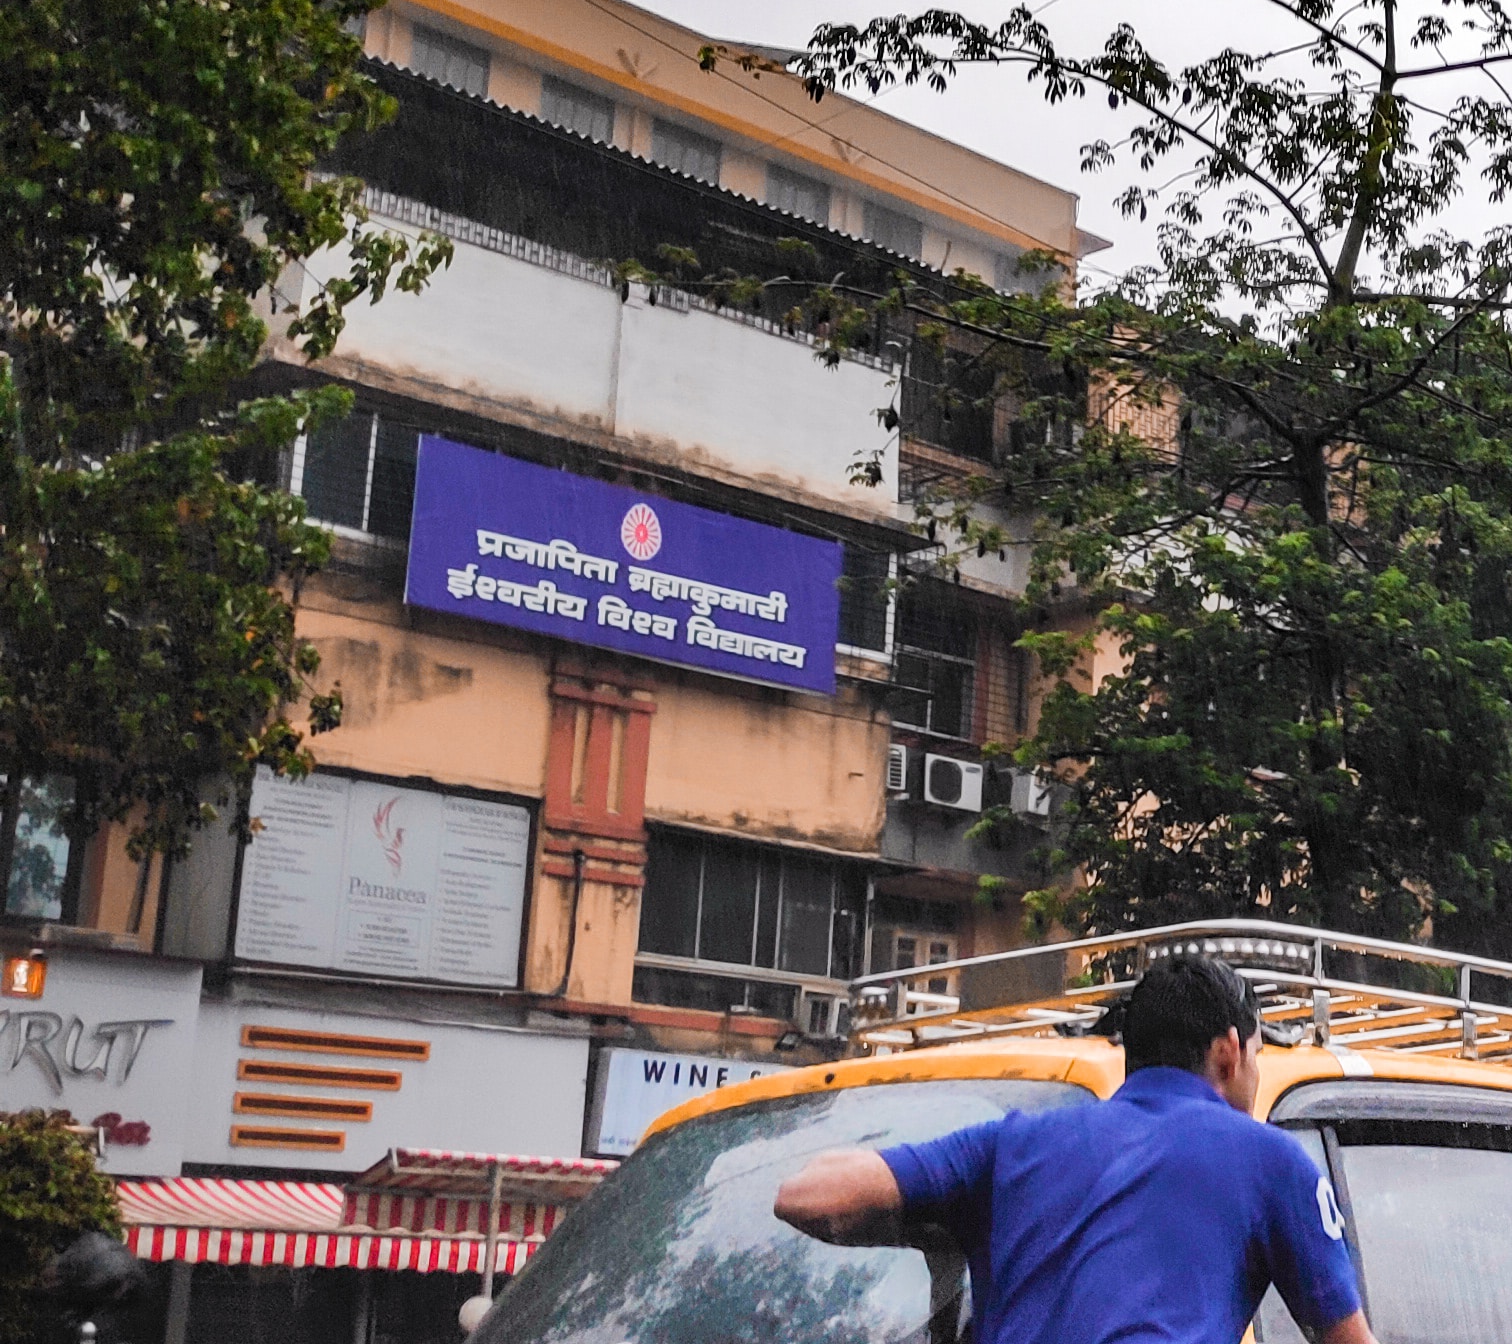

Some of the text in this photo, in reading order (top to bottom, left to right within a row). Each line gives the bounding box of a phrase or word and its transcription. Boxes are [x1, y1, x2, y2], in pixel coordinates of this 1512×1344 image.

[447, 564, 807, 669] ईश्वरीय विश्व विद्यालय
[476, 529, 788, 623] प्रजापिता ब्रह्माकुमारी
[0, 1008, 175, 1097] RUT
[643, 1059, 729, 1088] WINE
